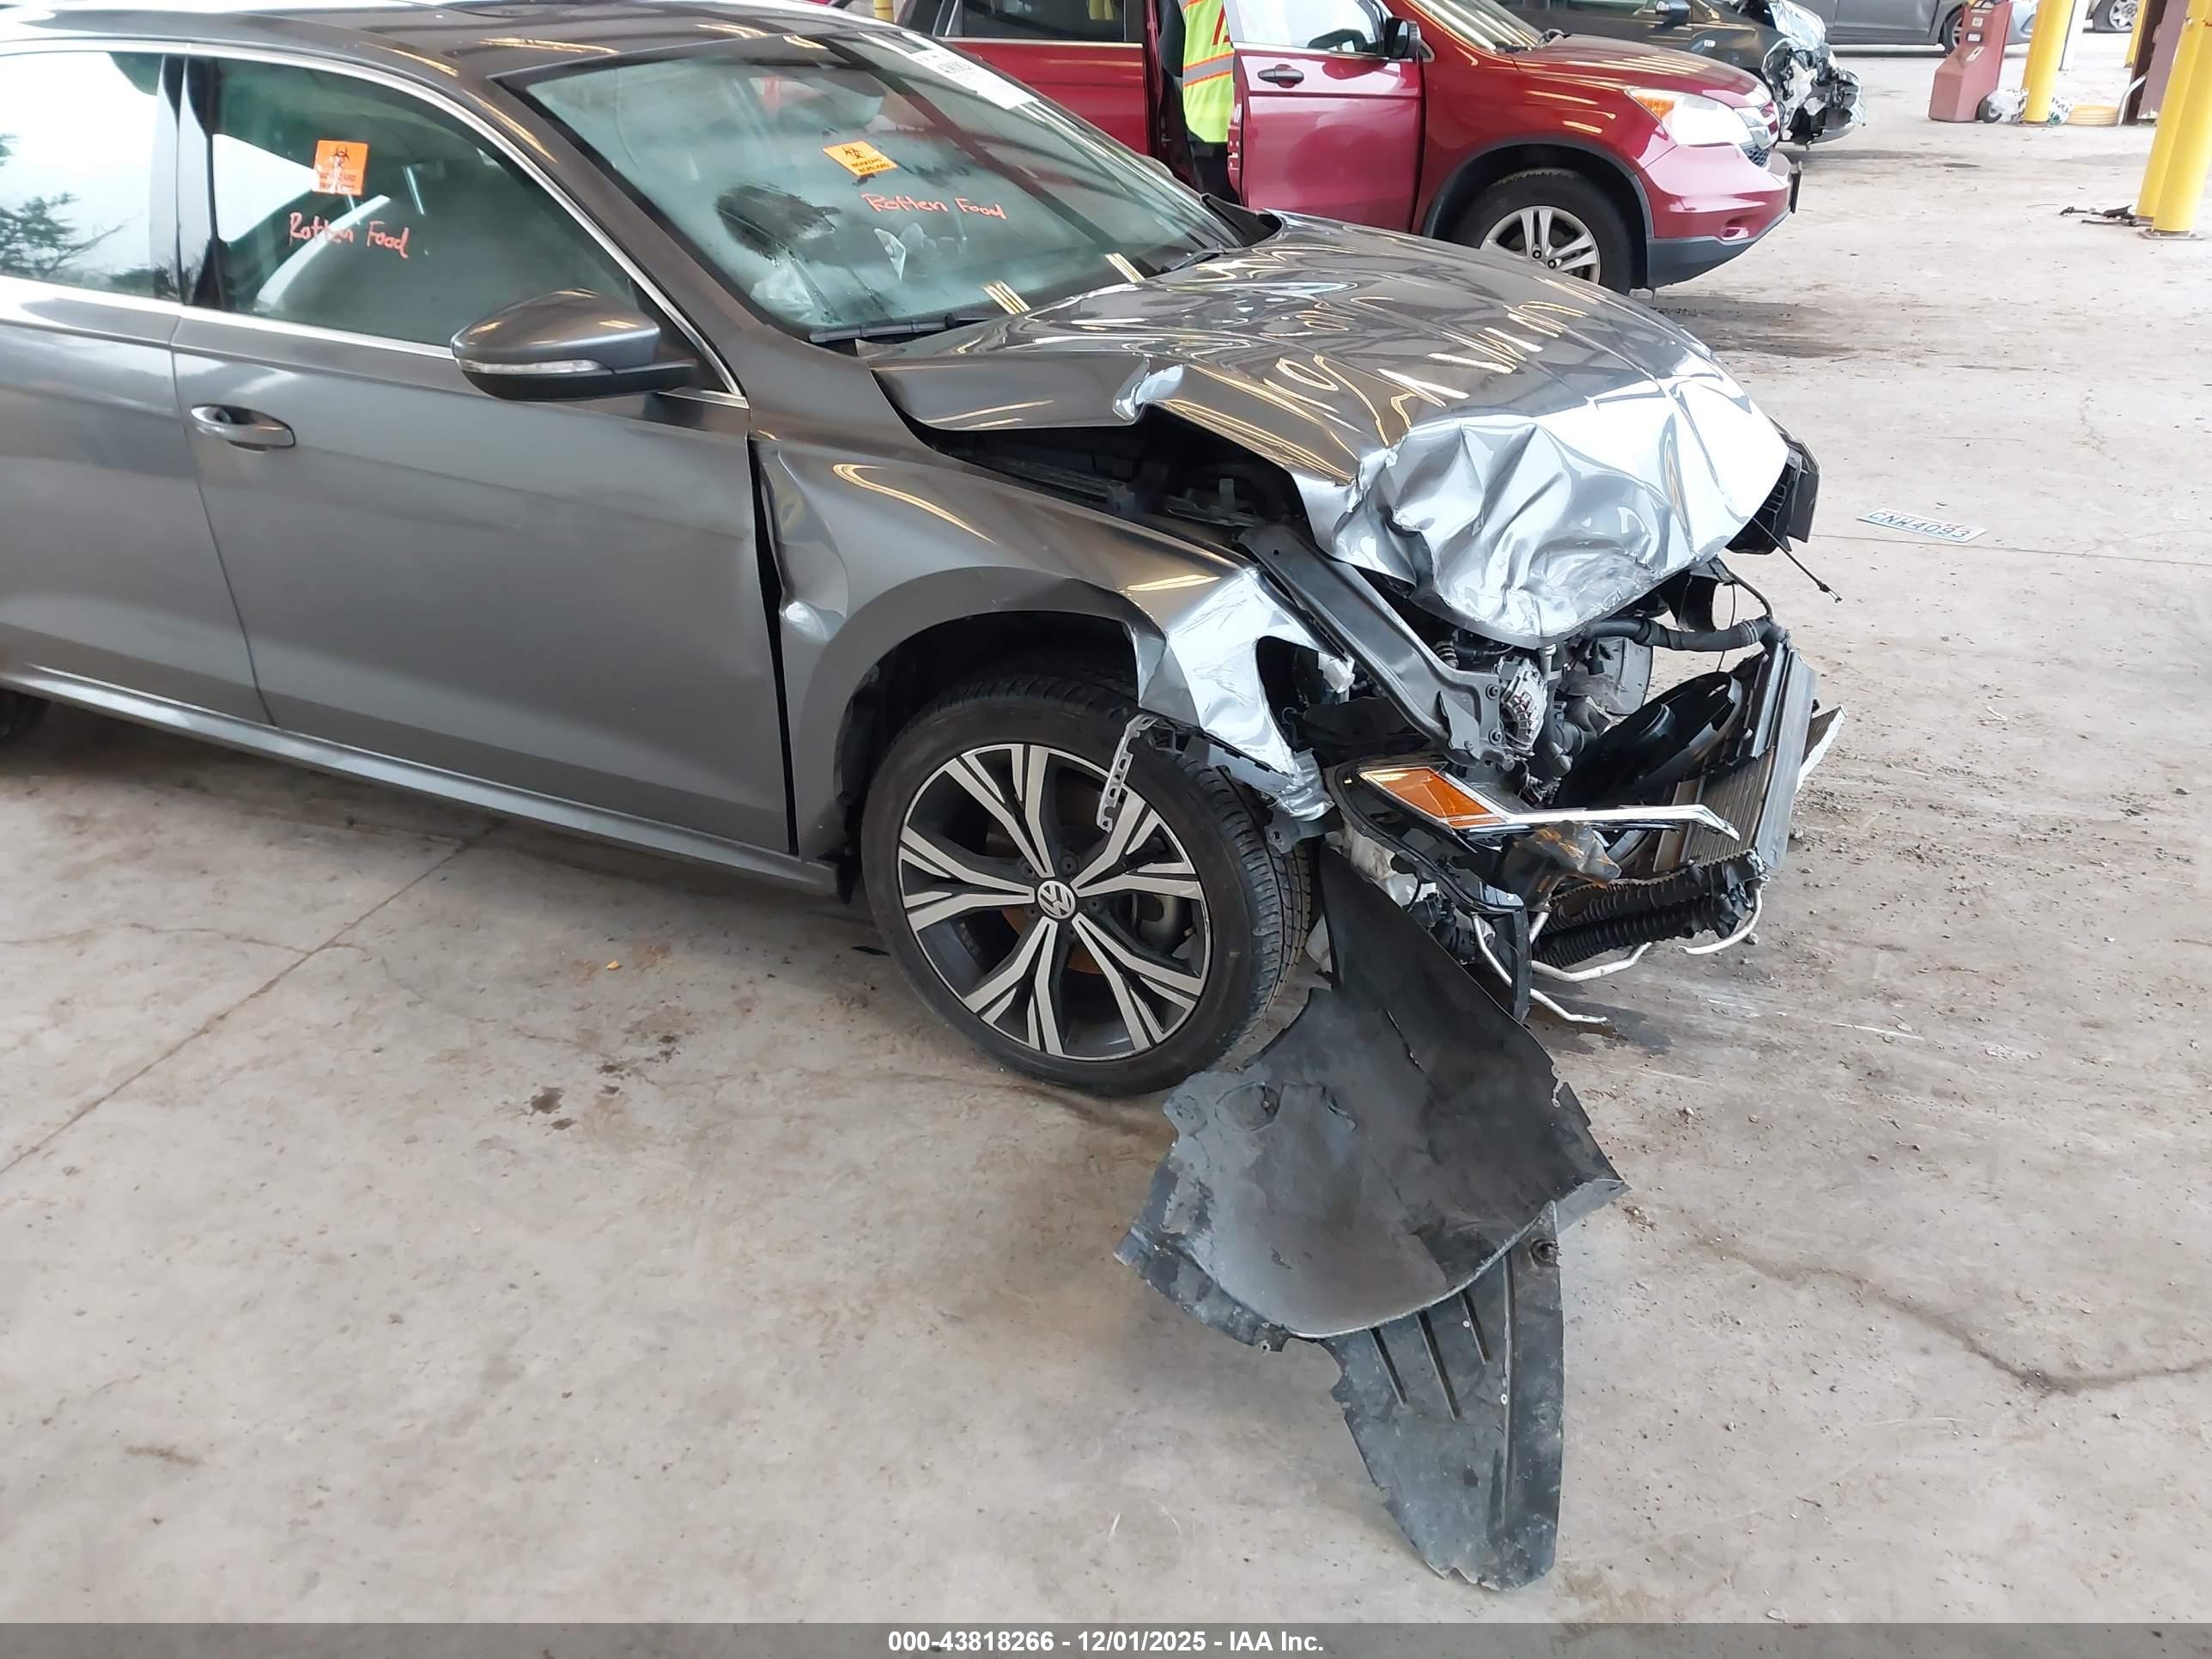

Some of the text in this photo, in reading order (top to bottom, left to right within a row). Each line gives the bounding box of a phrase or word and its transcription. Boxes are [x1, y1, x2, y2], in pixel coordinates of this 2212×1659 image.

[860, 191, 1006, 220] Rotten Food
[289, 212, 409, 258] Rotten Food
